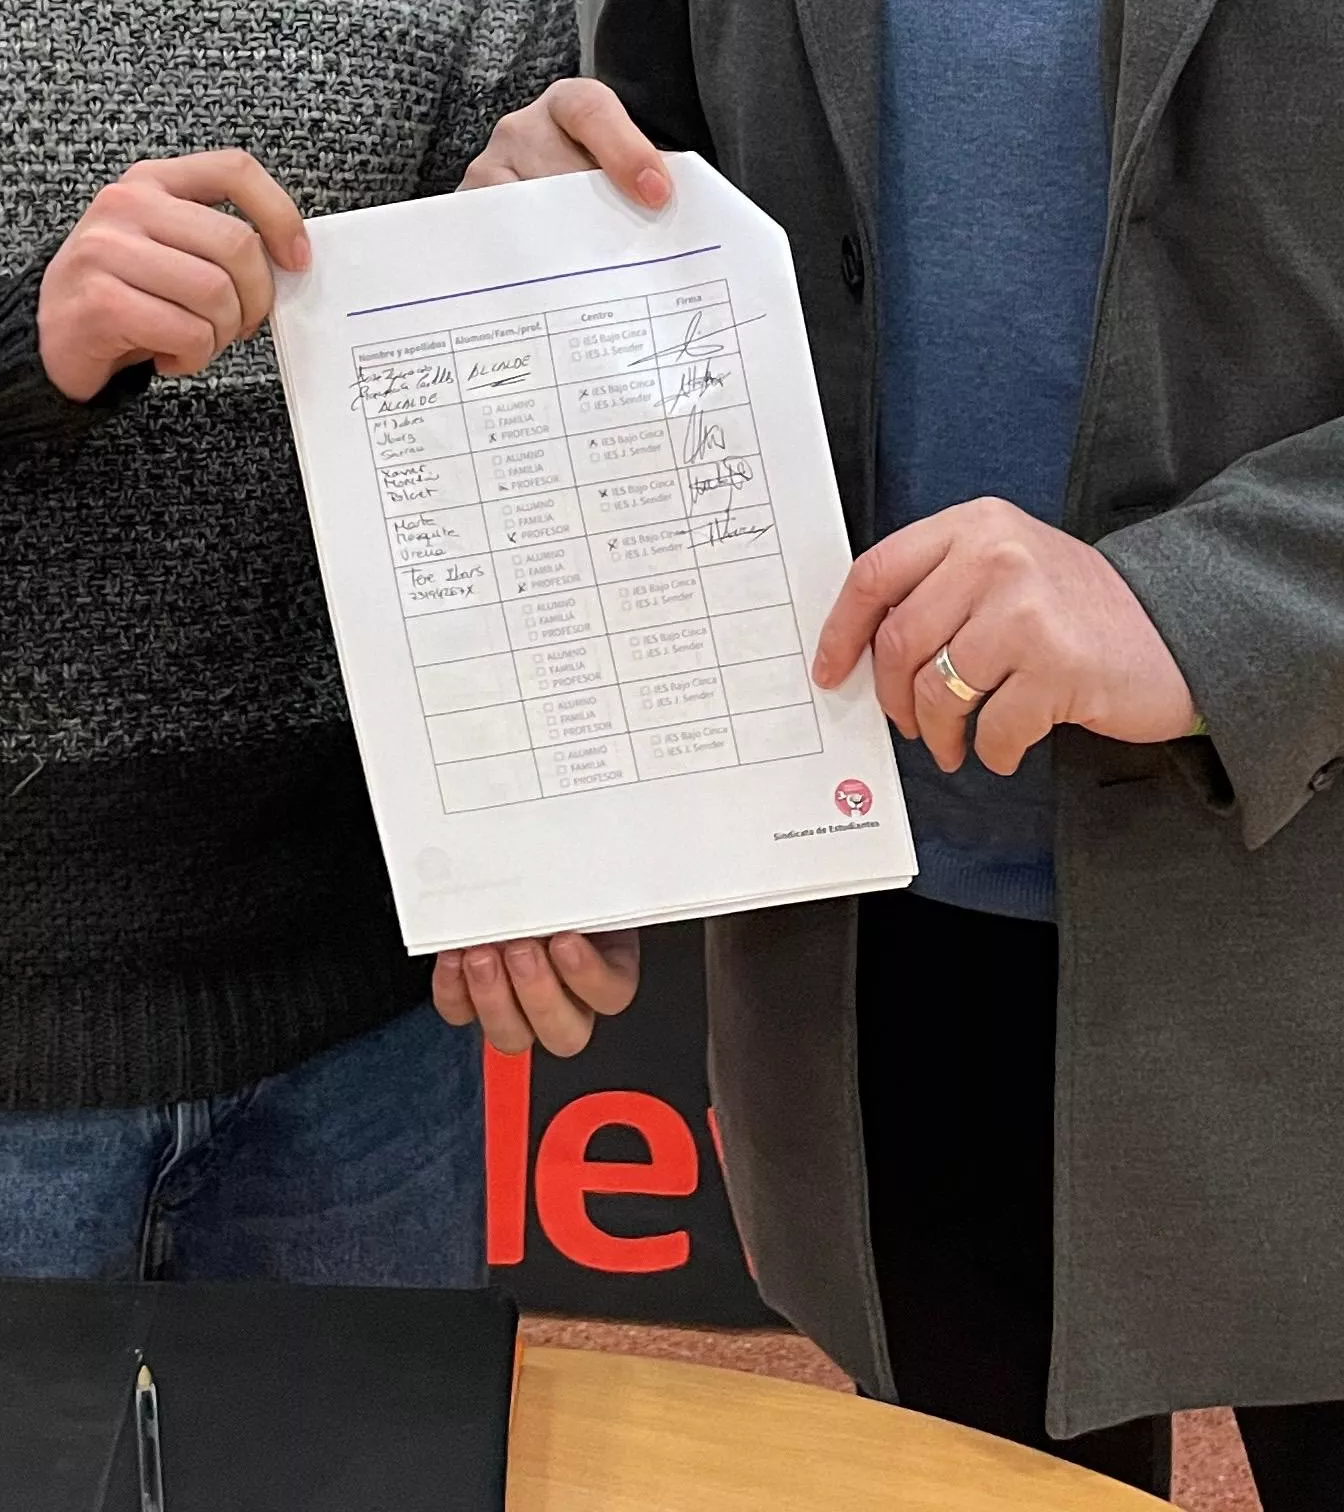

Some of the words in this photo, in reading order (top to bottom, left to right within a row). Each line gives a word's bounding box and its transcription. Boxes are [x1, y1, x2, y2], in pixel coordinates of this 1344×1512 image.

[358, 348, 394, 362] Nombre
[404, 340, 446, 355] apellidos
[581, 311, 614, 323] Centro
[675, 294, 702, 307] Firma
[583, 334, 598, 345] IES
[622, 328, 647, 339] Cinca
[585, 349, 600, 360] IES
[612, 342, 644, 356] Sender
[592, 385, 606, 396] IES
[630, 378, 655, 389] Cinca
[495, 399, 535, 414] ALUMNO
[594, 399, 609, 410] IES
[620, 393, 651, 406] Sender
[501, 425, 550, 440] PROFESOR
[601, 436, 616, 446] IES
[639, 429, 664, 440] Cinca
[506, 449, 545, 463] ALUMNO
[604, 449, 619, 459] IES
[630, 443, 661, 456] Sender
[512, 475, 560, 490] PROFESOR
[612, 486, 626, 496] IES
[650, 479, 675, 490] Cinca
[516, 499, 555, 513] ALUMNO
[614, 499, 630, 509] IES
[640, 493, 672, 505] Sender
[521, 524, 570, 539] PROFESOR
[622, 536, 637, 546] IES
[526, 549, 565, 563] ALUMNO
[625, 549, 640, 559] IES
[651, 543, 683, 556] Sender
[532, 574, 581, 588] PROFESOR
[633, 586, 647, 596] IES
[671, 578, 697, 589] Cinca
[536, 598, 576, 612] ALUMNO
[635, 599, 650, 609] IES
[661, 592, 694, 605] Sender
[542, 623, 591, 638] PROFESOR
[644, 635, 658, 645] IES
[681, 627, 707, 638] Cinca
[547, 647, 586, 661] ALUMNO
[647, 648, 661, 658] IES
[672, 641, 704, 654] Sender
[552, 672, 602, 687] PROFESOR
[654, 684, 668, 694] IES
[692, 677, 717, 688] Cinca
[558, 696, 597, 710] ALUMNO
[657, 698, 672, 707] IES
[683, 691, 714, 703] Sender
[563, 721, 612, 737] PROFESOR
[665, 734, 679, 743] IES
[703, 726, 728, 737] Cinca
[568, 745, 608, 759] ALUMNO
[667, 747, 682, 756] IES
[692, 739, 725, 753] Sender
[573, 770, 623, 786] PROFESOR
[816, 826, 826, 835] de
[485, 1040, 756, 1280] le
